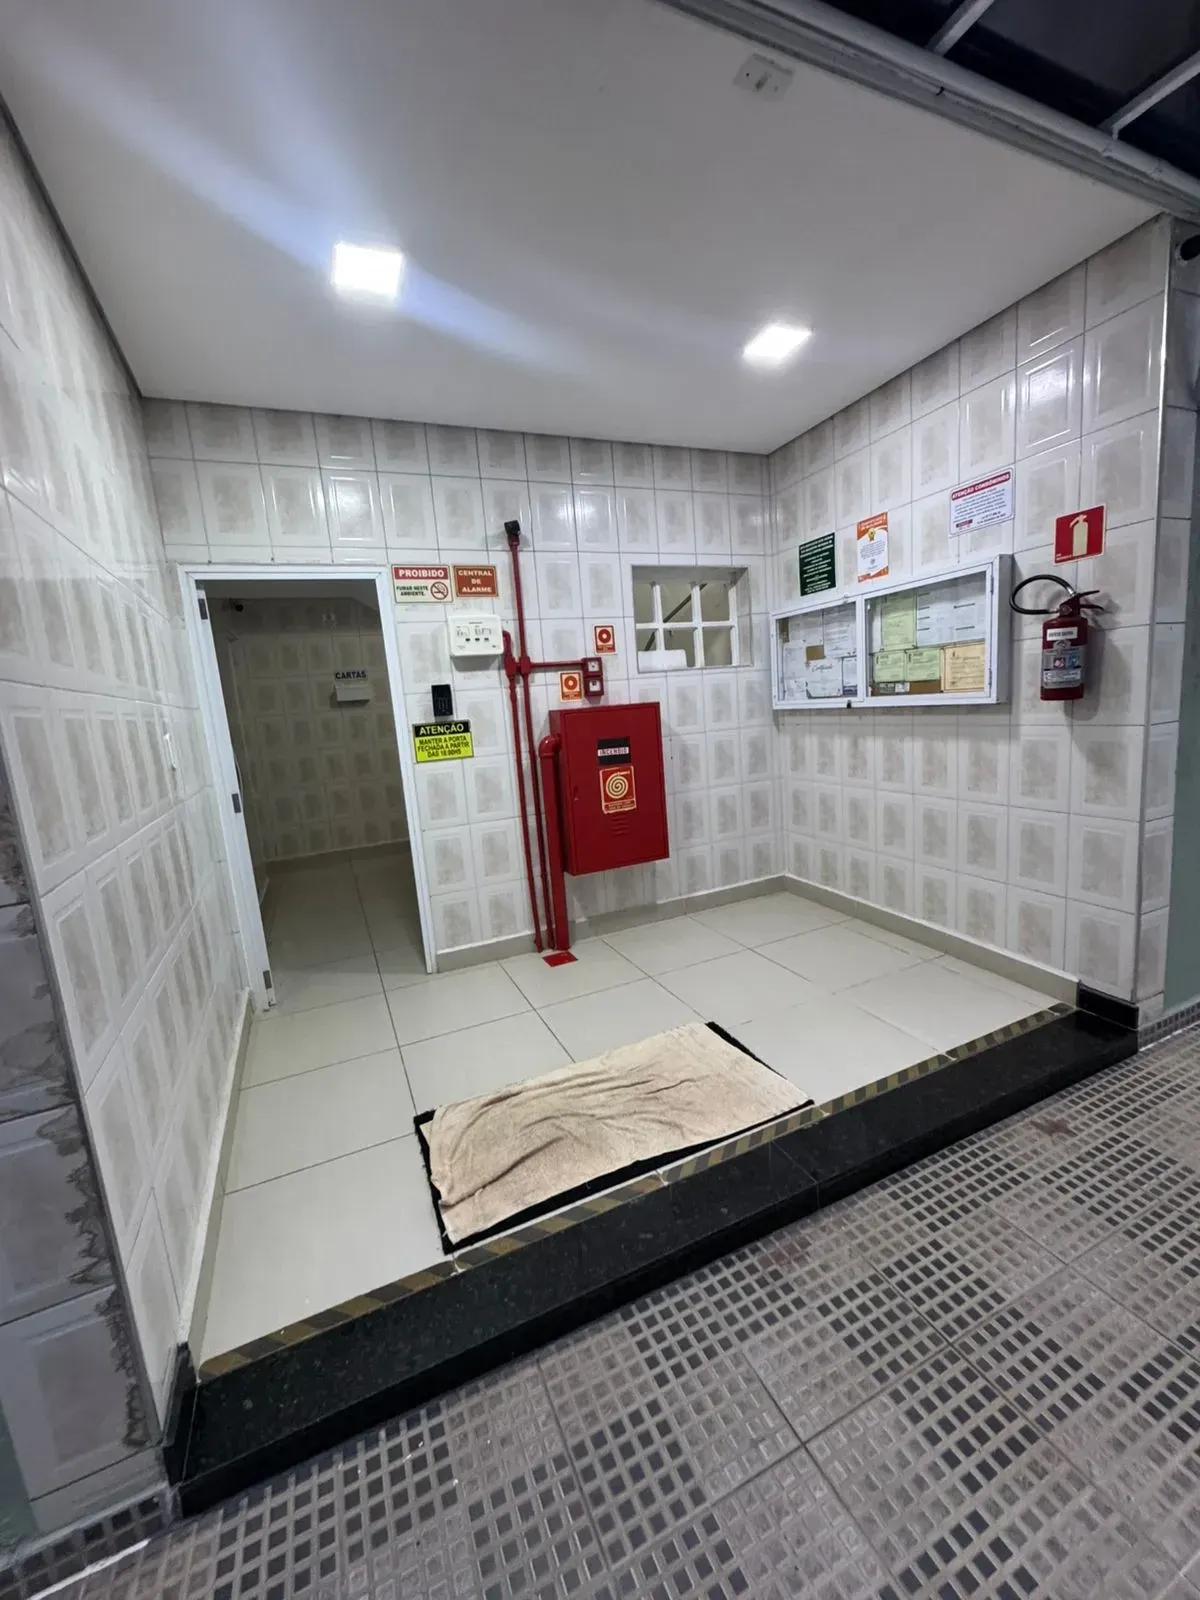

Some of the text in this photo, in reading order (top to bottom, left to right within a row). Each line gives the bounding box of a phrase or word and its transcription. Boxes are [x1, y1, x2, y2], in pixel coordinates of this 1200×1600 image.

[398, 569, 445, 578] PROIBIDO
[458, 569, 493, 577] CENTRAL
[335, 671, 367, 679] CARTAS
[420, 723, 465, 735] ATENÇÃO
[419, 737, 443, 746] MANTER
[417, 743, 444, 752] FECHADA
[450, 741, 470, 749] PARTIR
[427, 750, 440, 758] DAS
